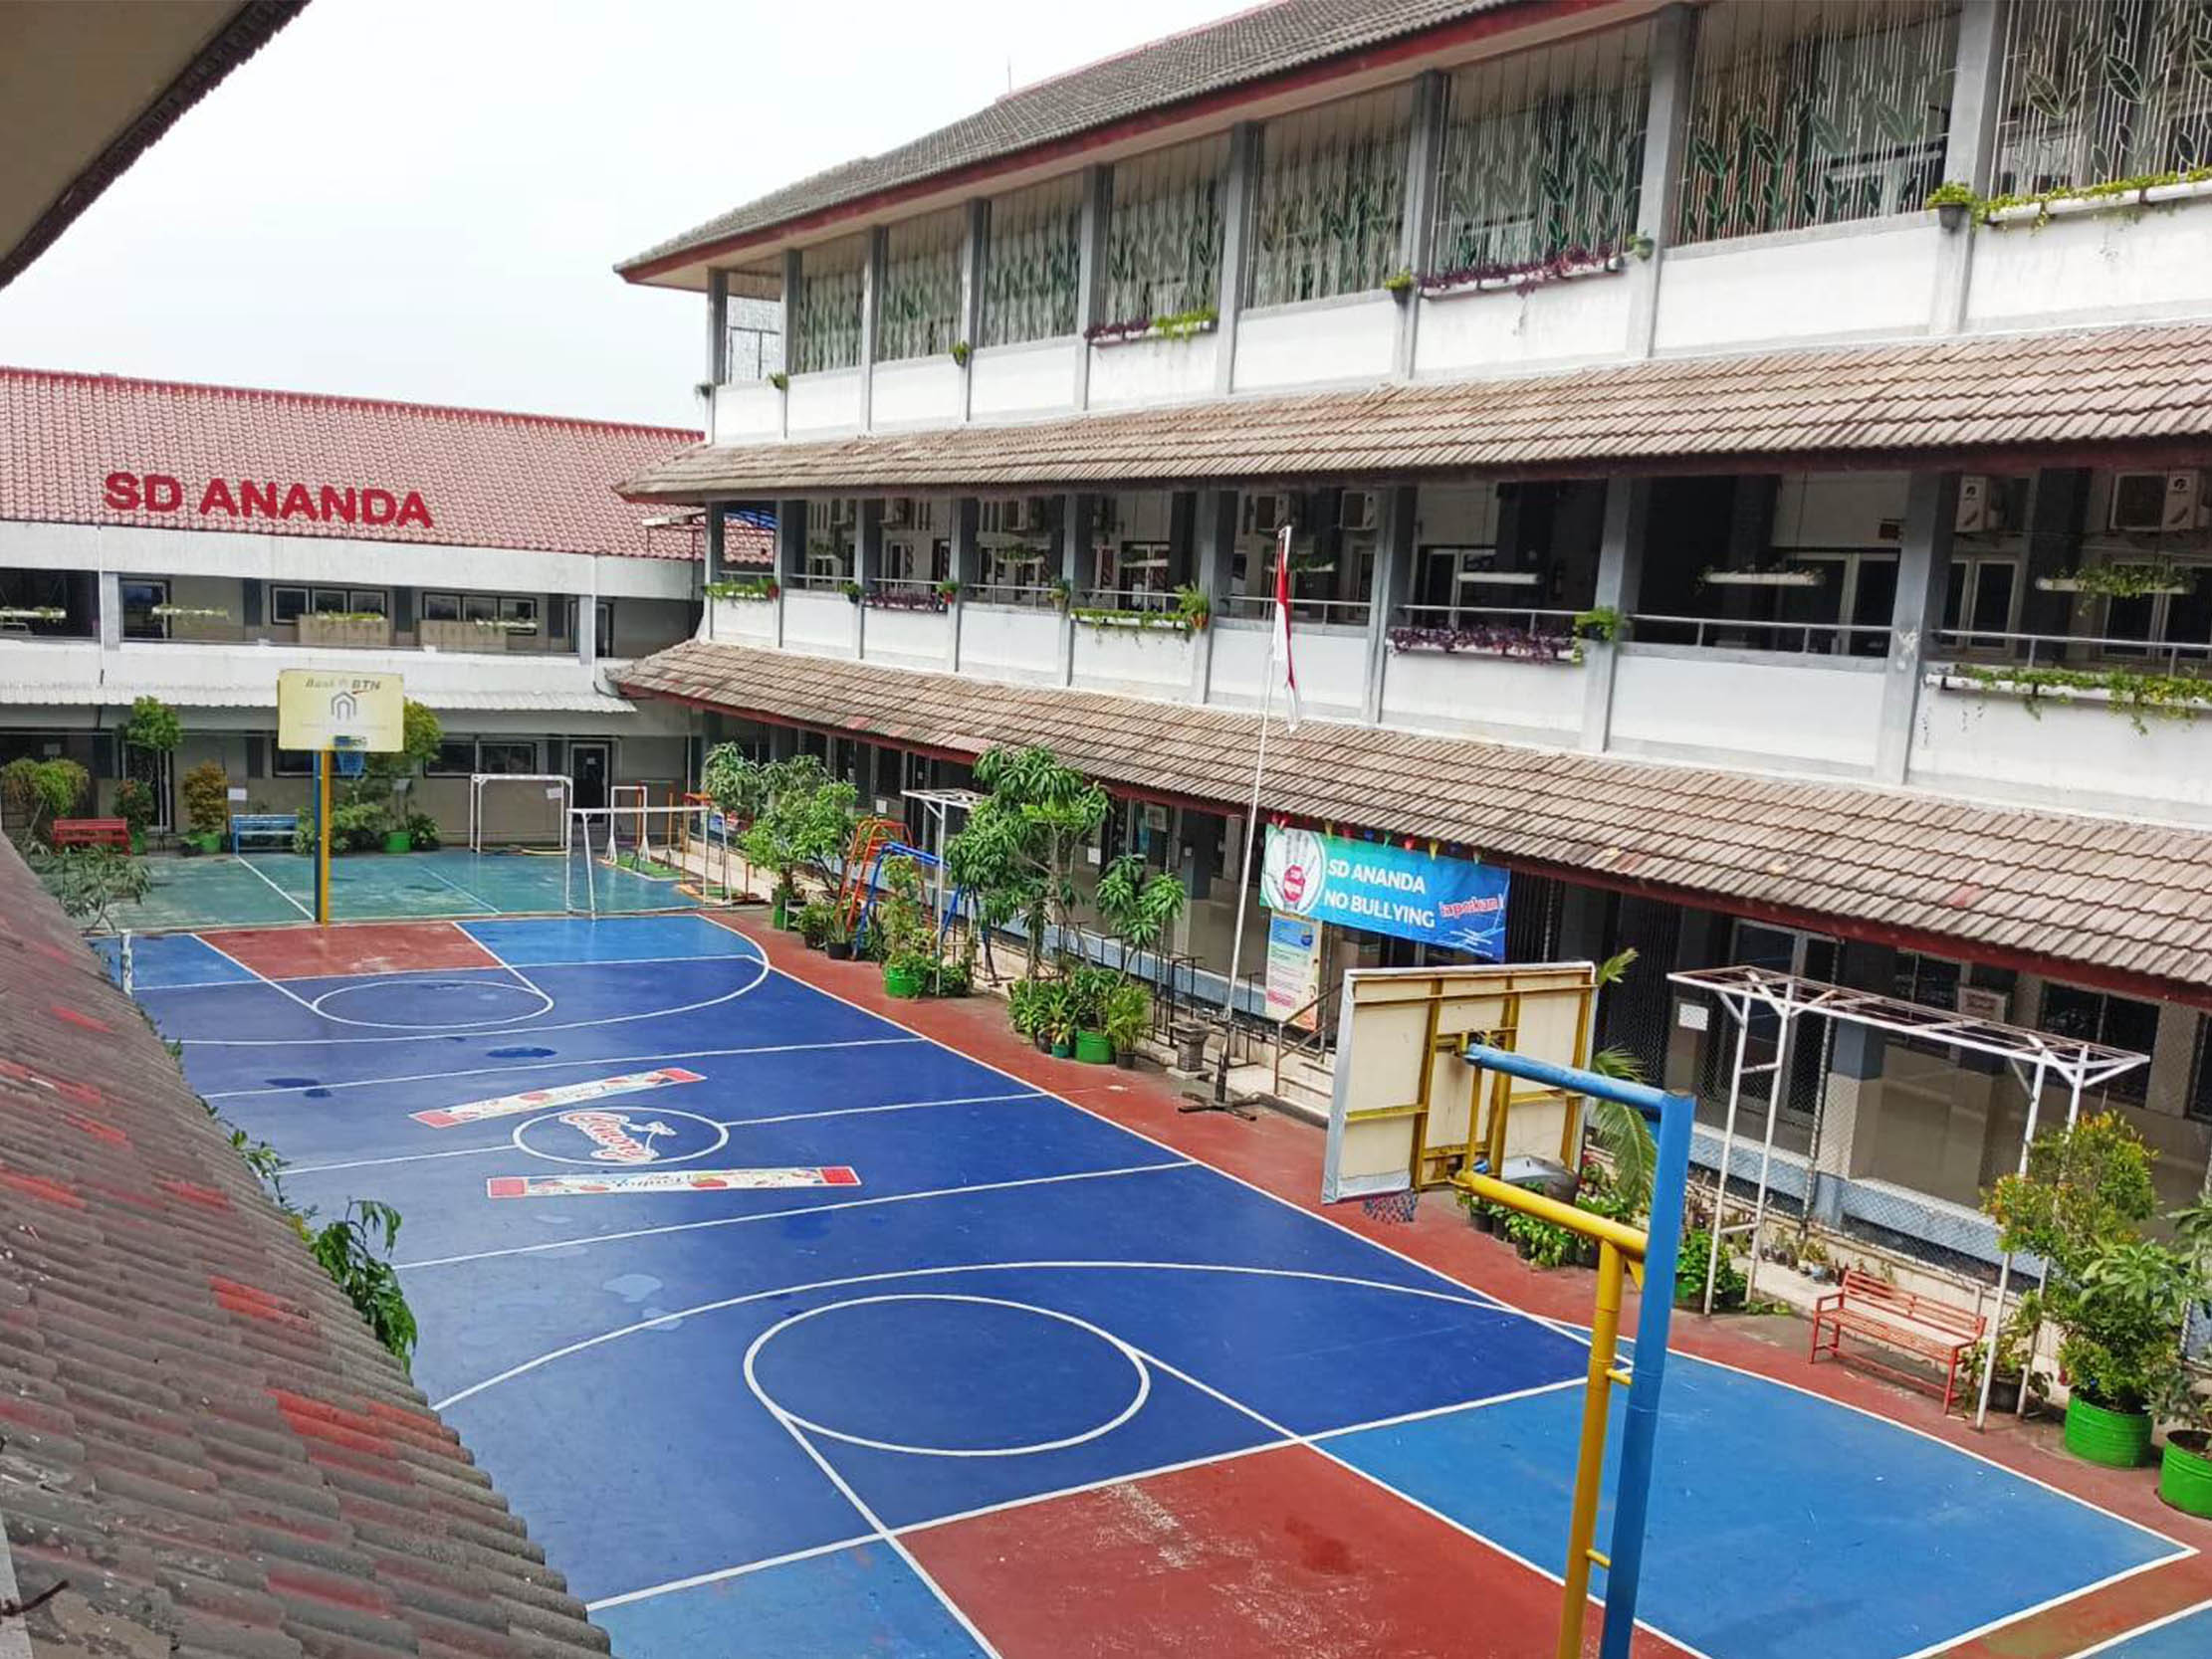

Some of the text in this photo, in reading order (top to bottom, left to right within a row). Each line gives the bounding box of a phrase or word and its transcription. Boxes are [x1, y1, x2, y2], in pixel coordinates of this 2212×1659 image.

[106, 472, 433, 528] SD ANANDA
[351, 679, 380, 691] BTN
[1327, 859, 1426, 895] SD ANANDA
[1324, 889, 1436, 929] NO BULLYING
